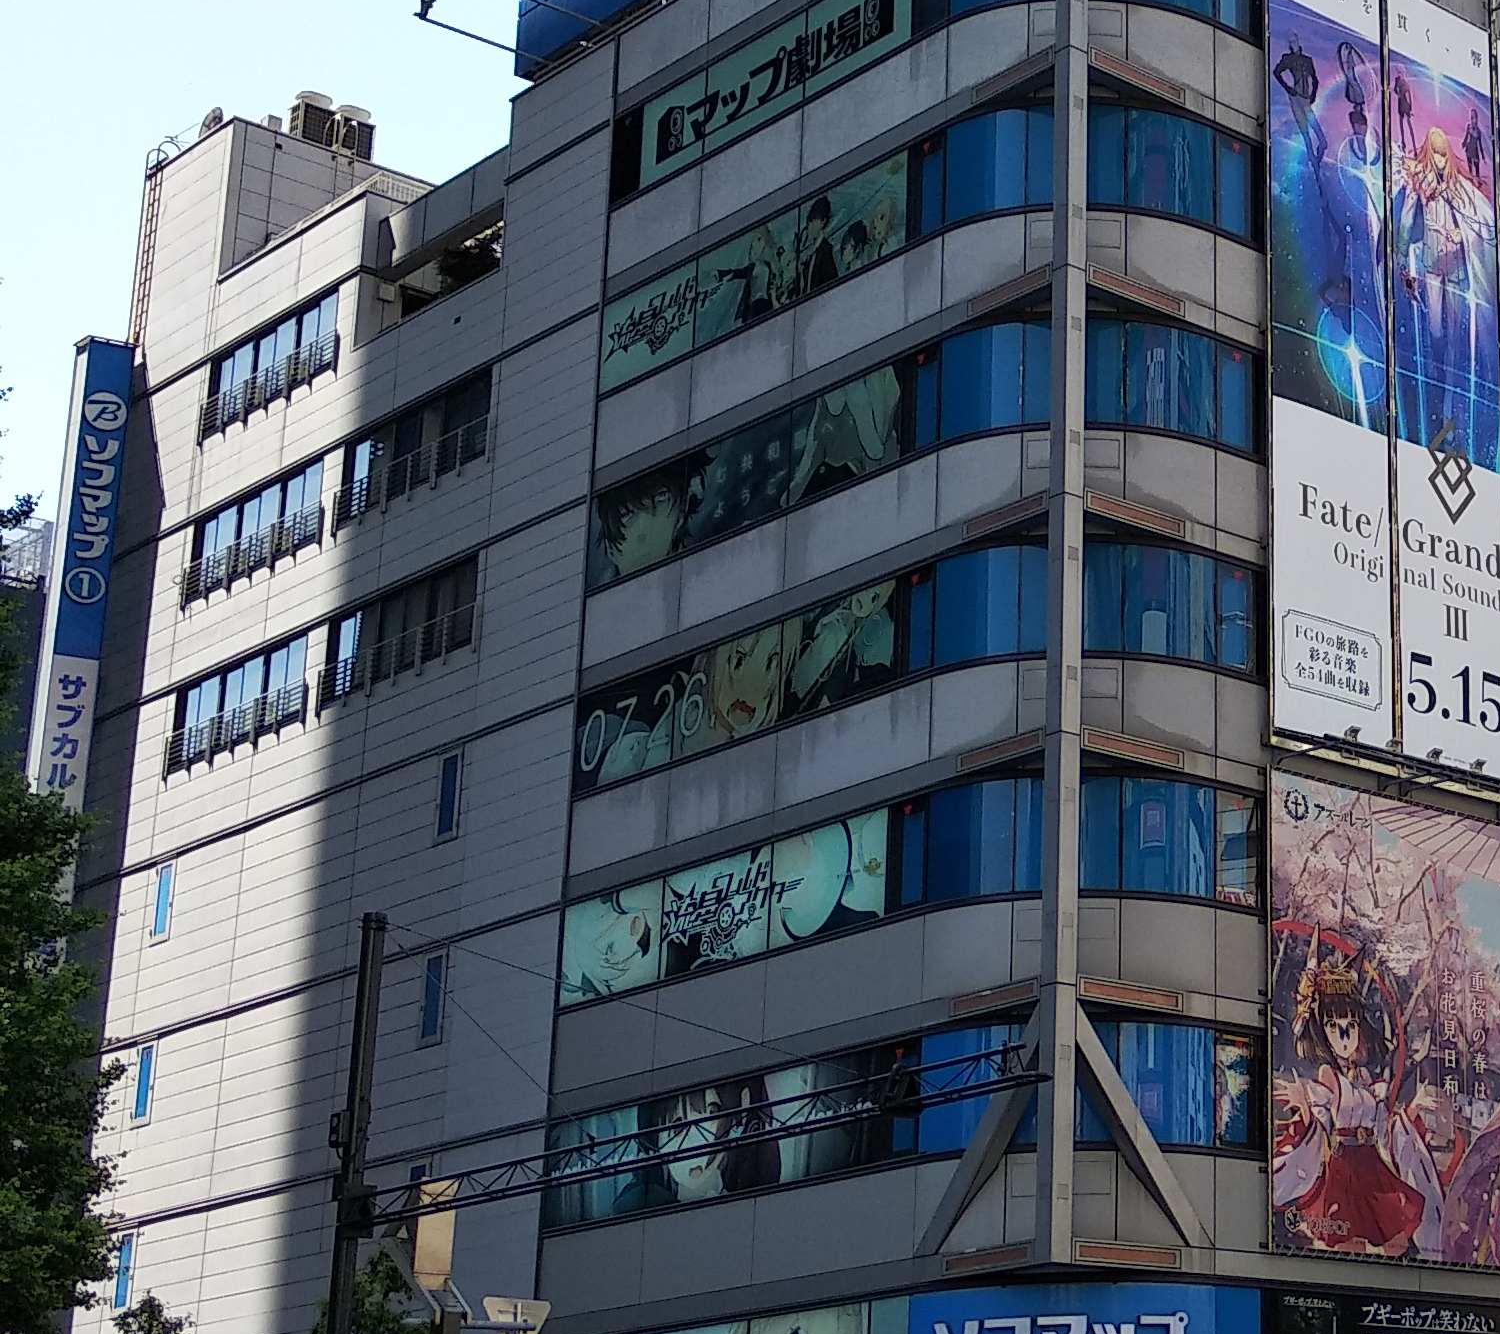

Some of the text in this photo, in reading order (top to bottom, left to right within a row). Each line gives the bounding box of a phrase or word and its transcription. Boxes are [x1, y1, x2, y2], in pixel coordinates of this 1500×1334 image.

[685, 5, 863, 144] マップ劇場
[75, 435, 120, 561] ソフマップ
[1295, 623, 1369, 659] FGOの旅路を
[1309, 646, 1356, 675] 彩る音楽
[1294, 661, 1370, 697] 全54曲を収録
[1470, 972, 1487, 1101] 重桜の春は
[1361, 1301, 1496, 1333] ブギーポップは笑わない
